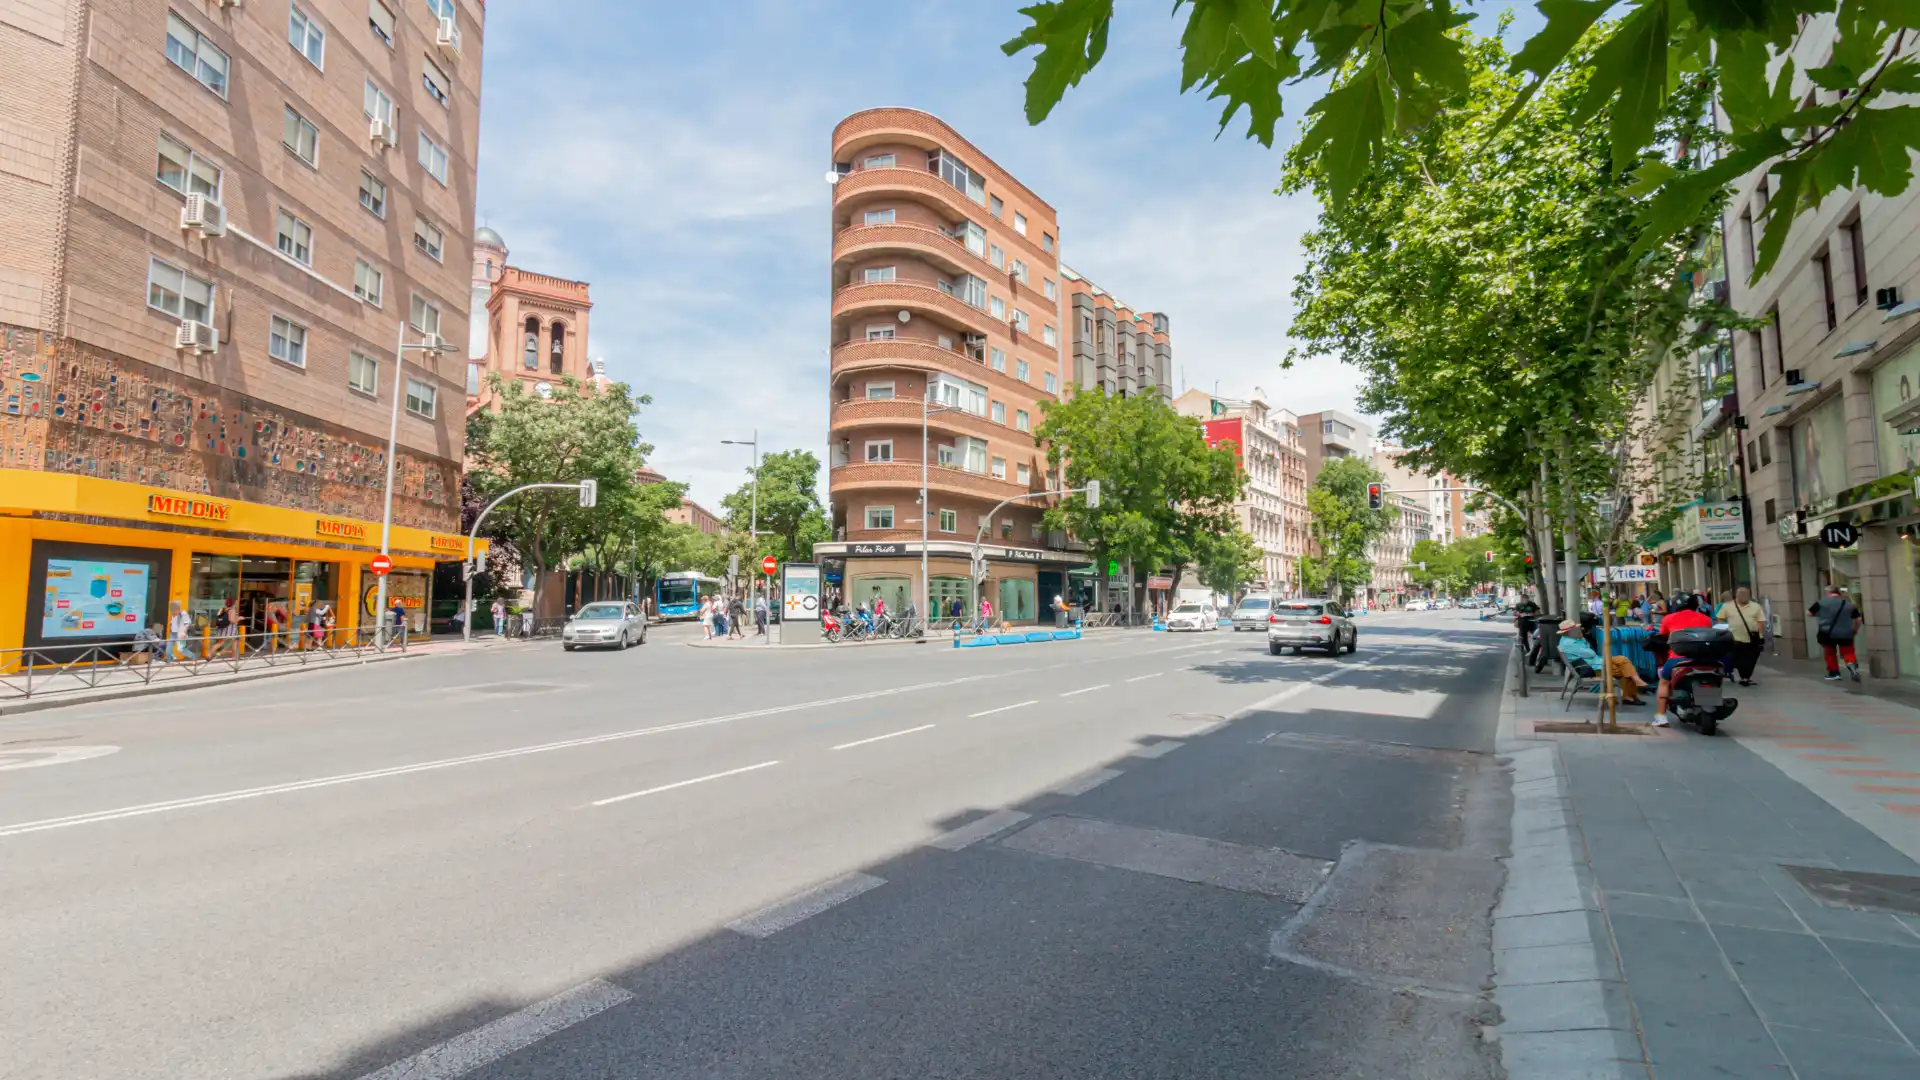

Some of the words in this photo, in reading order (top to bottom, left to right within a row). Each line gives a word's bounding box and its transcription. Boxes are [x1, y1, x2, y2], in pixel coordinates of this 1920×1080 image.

[1827, 527, 1851, 543] IN
[855, 545, 873, 553] Pilar
[874, 544, 896, 553] Prieto
